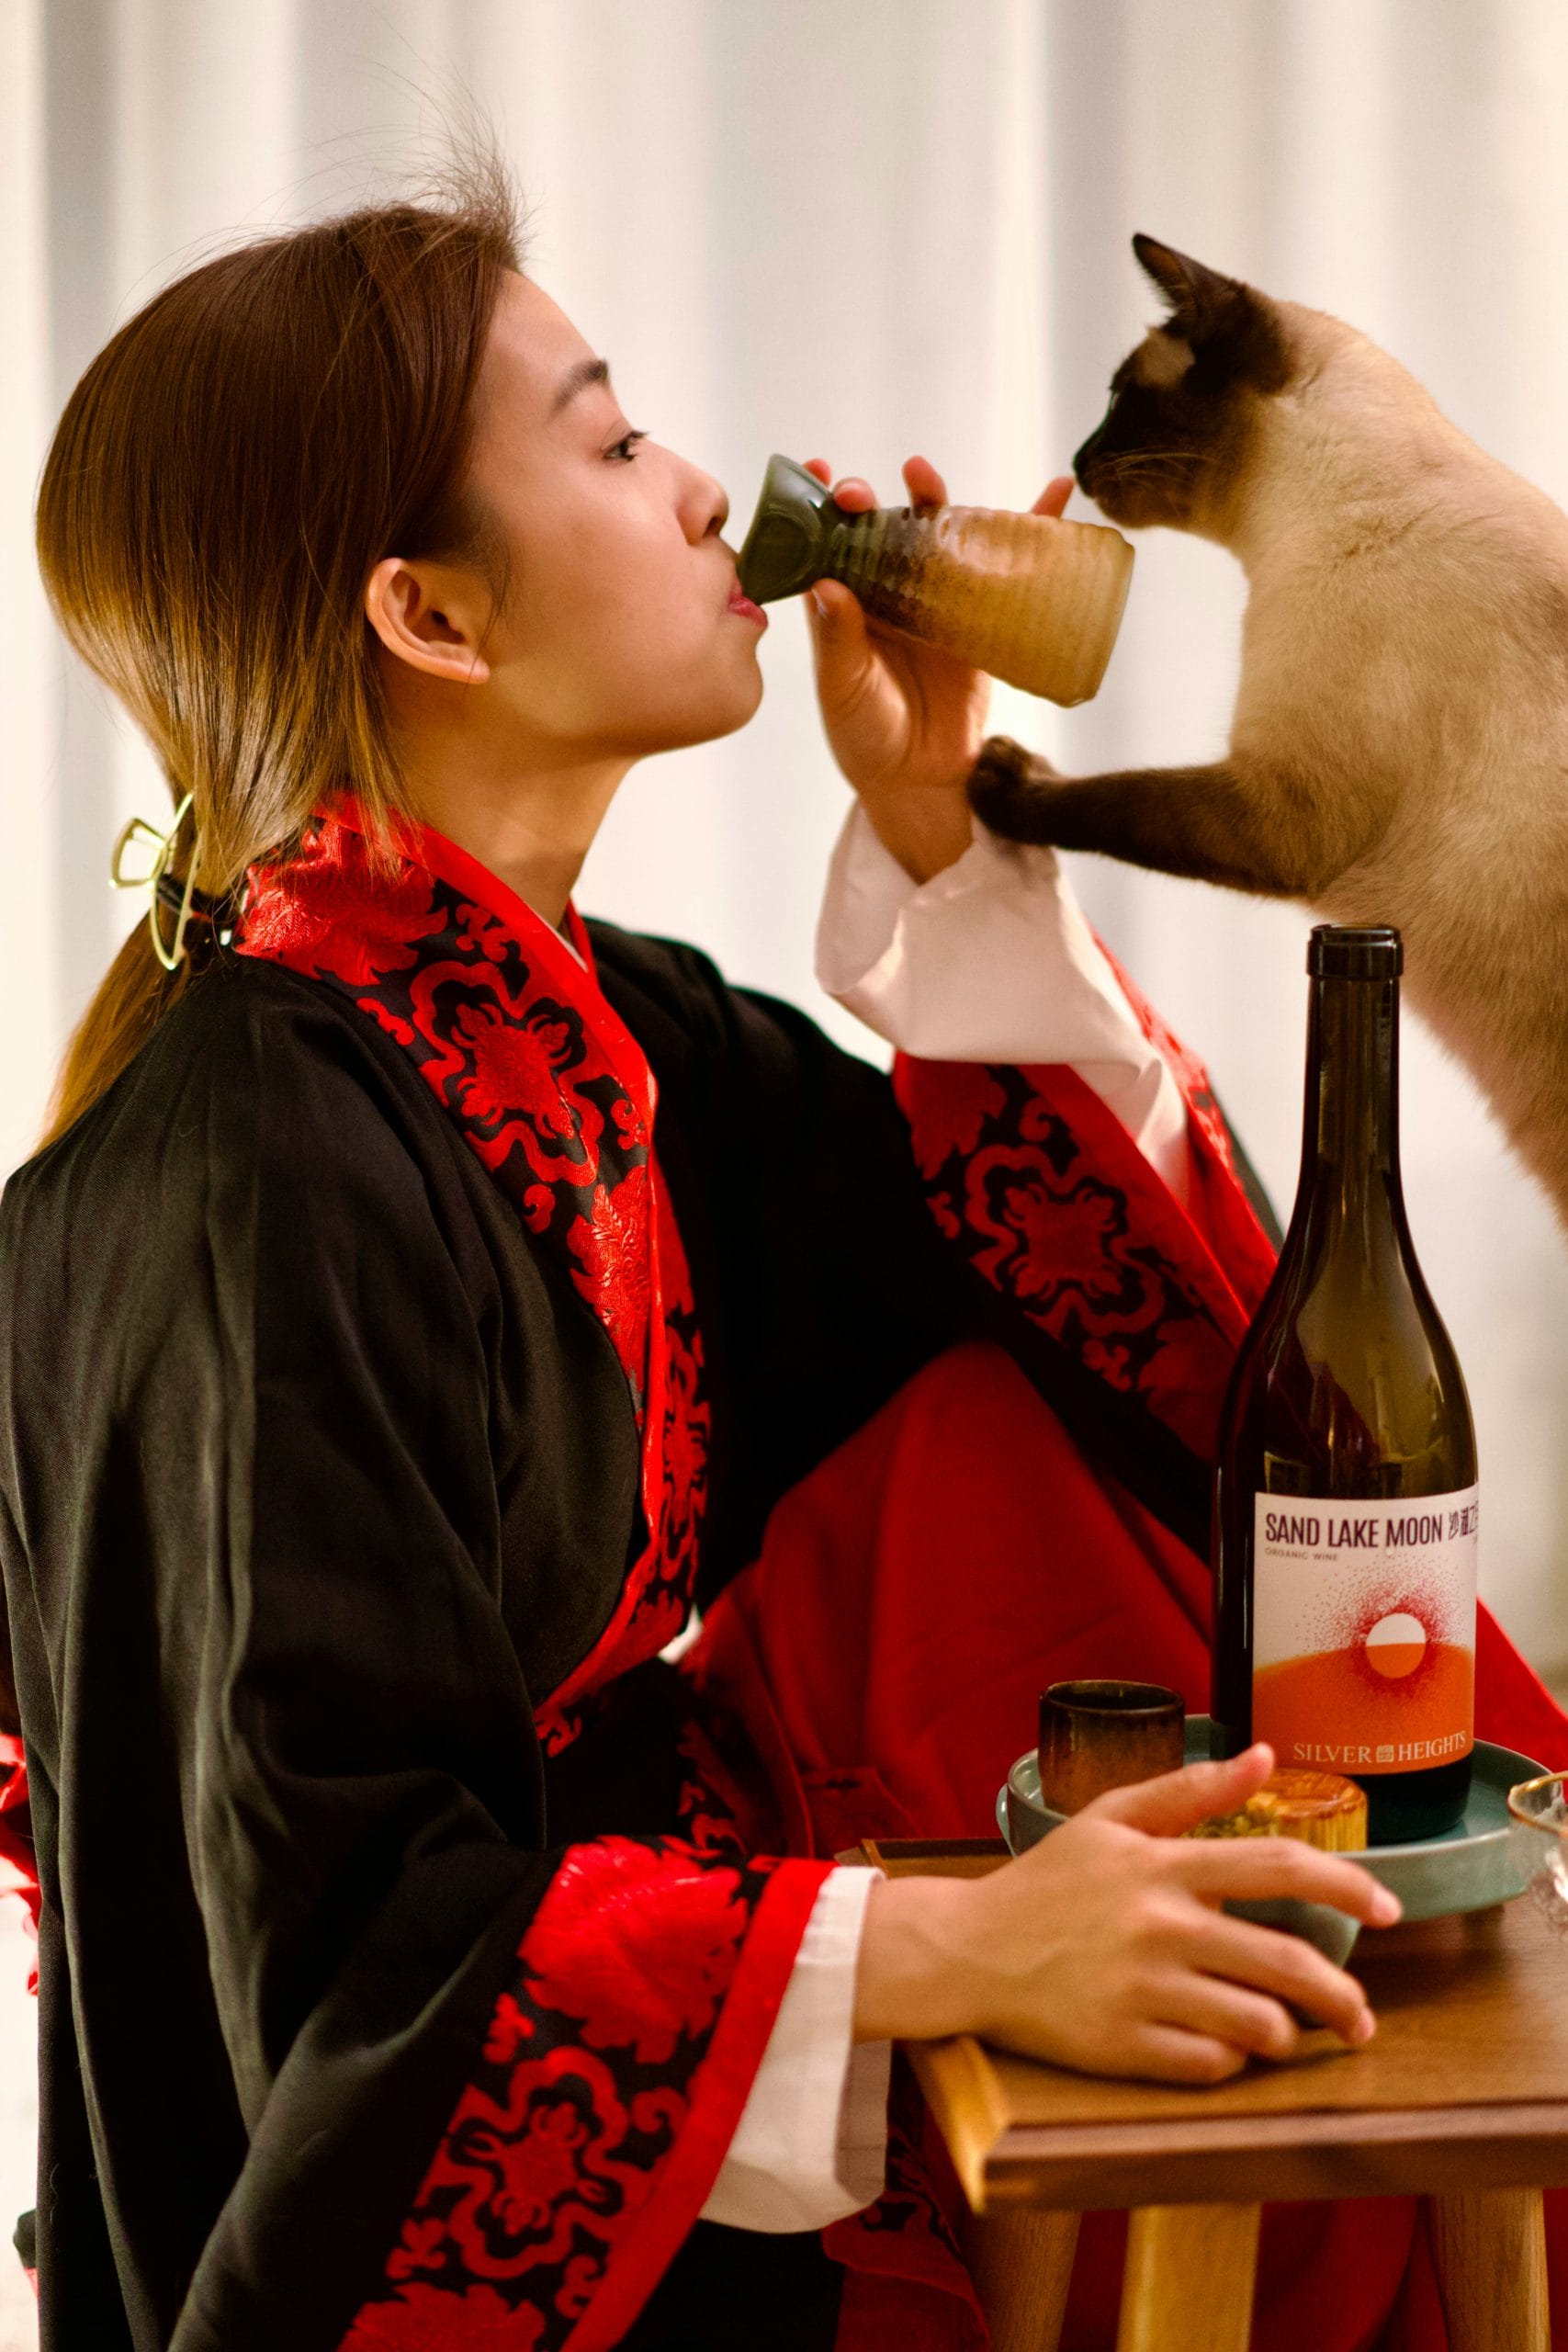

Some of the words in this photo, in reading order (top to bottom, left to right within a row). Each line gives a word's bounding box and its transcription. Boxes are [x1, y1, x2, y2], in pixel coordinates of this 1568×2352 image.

[1266, 1513, 1320, 1546] SAND
[1328, 1519, 1378, 1547] LAKE
[1386, 1514, 1442, 1546] MOON
[1265, 1547, 1308, 1560] ORGANIC
[1313, 1553, 1337, 1561] WINE
[1293, 1743, 1371, 1763] SILVER
[1398, 1731, 1465, 1761] HEIGHTS
